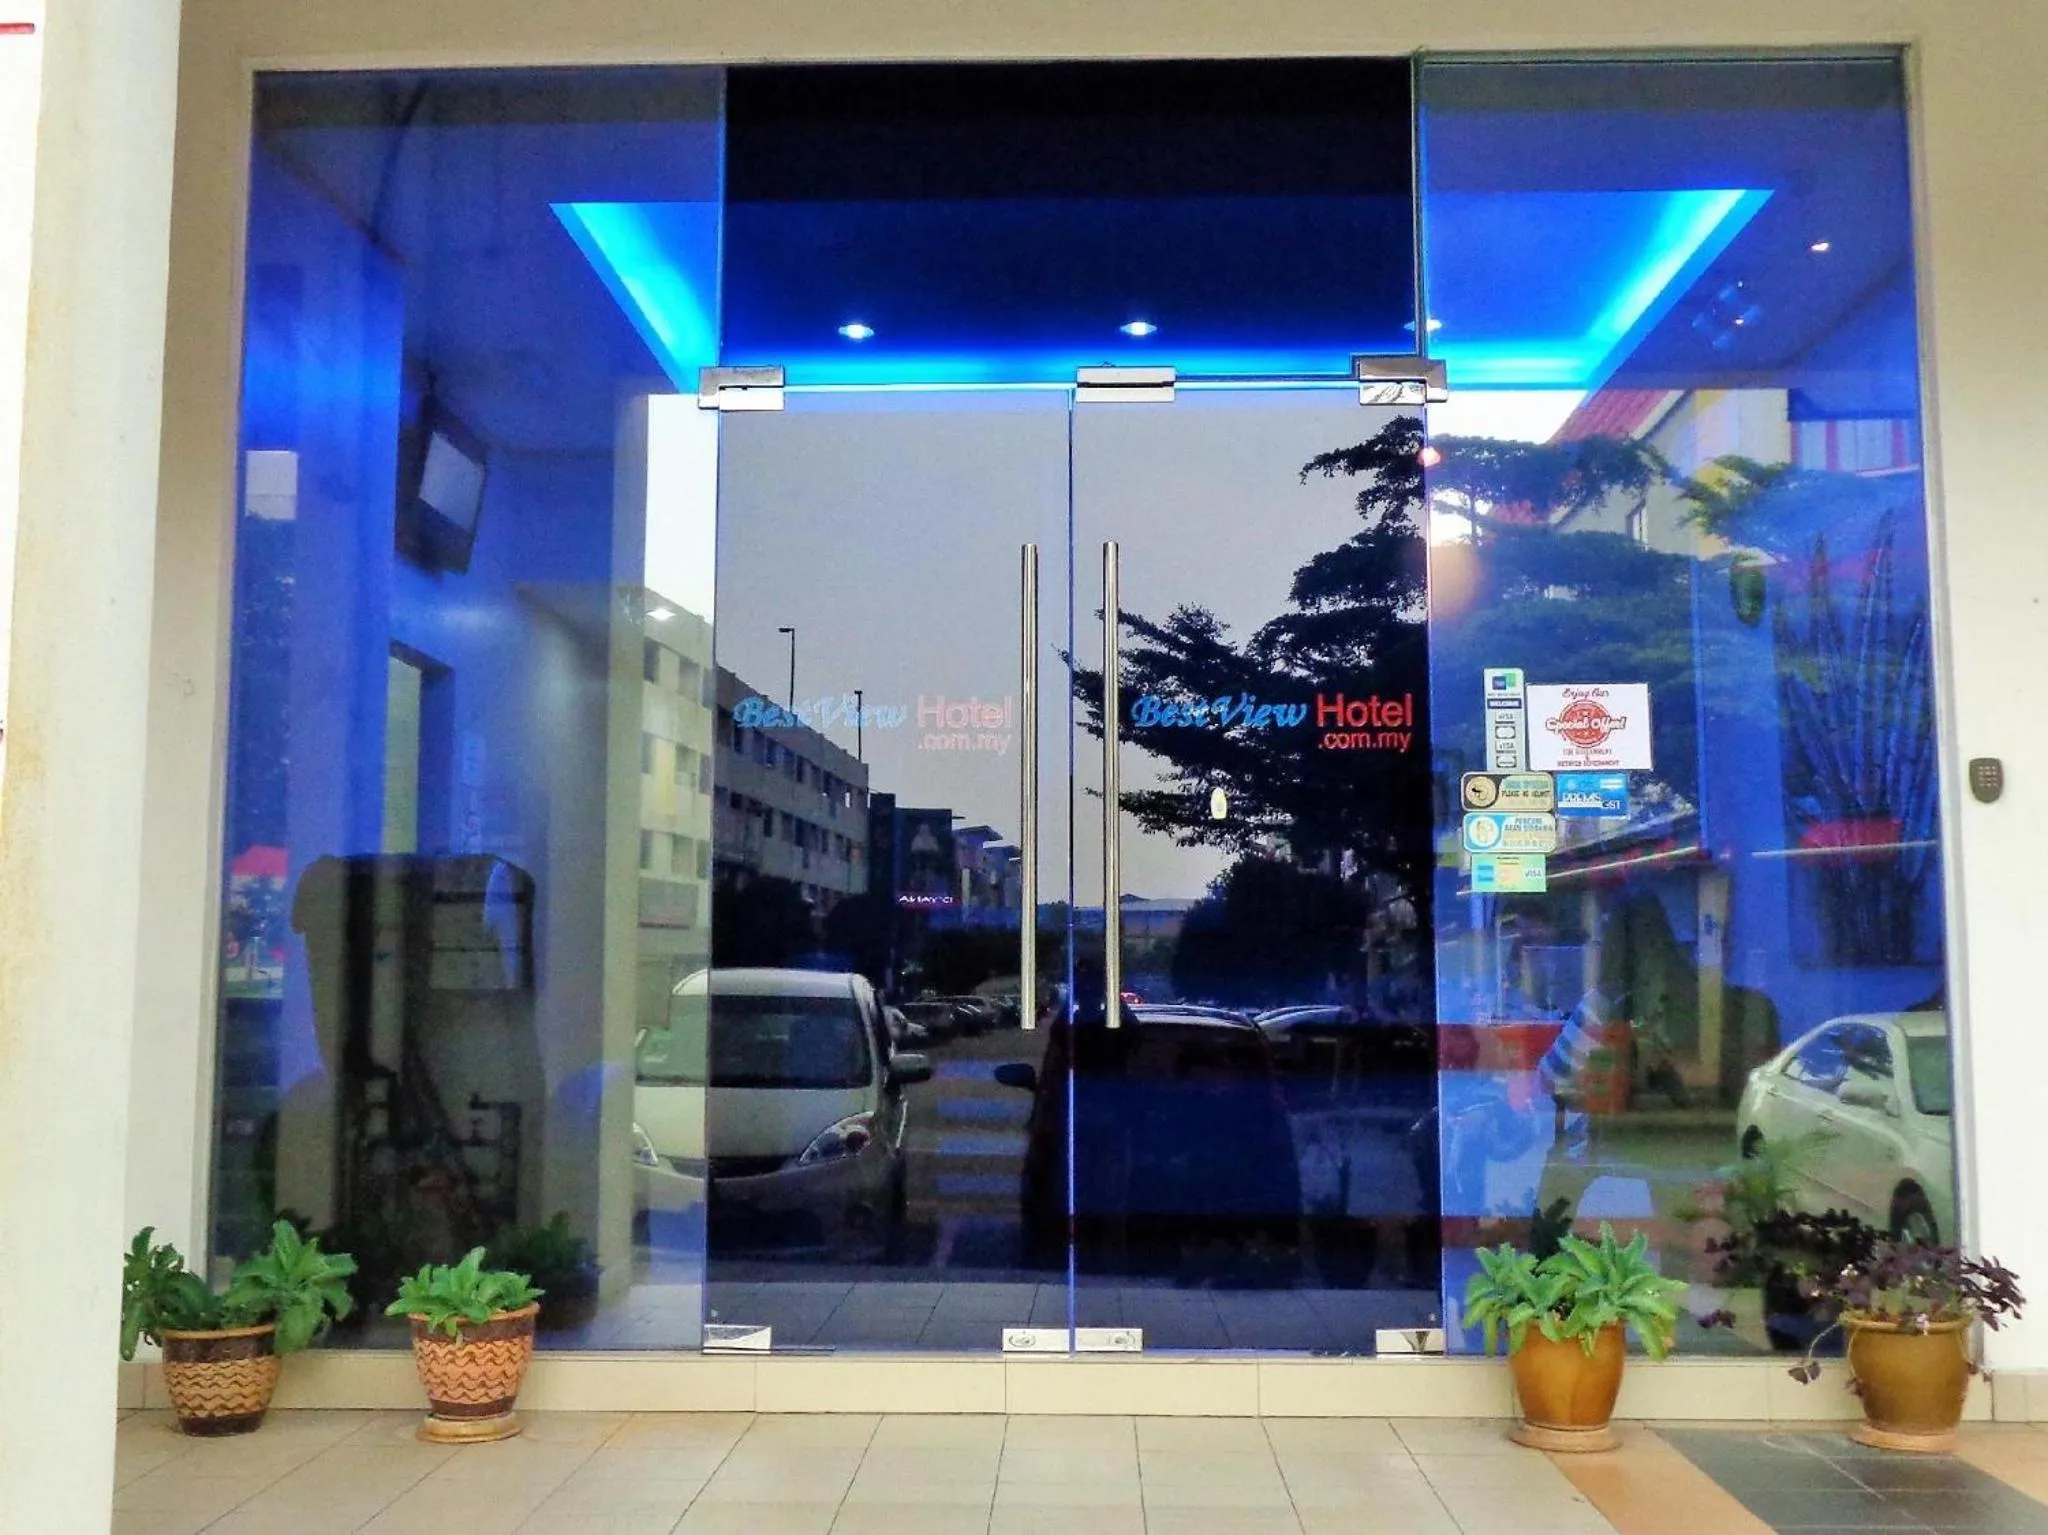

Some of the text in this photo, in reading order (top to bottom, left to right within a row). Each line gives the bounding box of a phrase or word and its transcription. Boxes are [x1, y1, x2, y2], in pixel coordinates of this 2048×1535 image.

[916, 696, 1012, 728] Hotel
[1317, 693, 1412, 727] Hotel
[919, 731, 1011, 755] .com.my
[1318, 731, 1411, 752] .com.my
